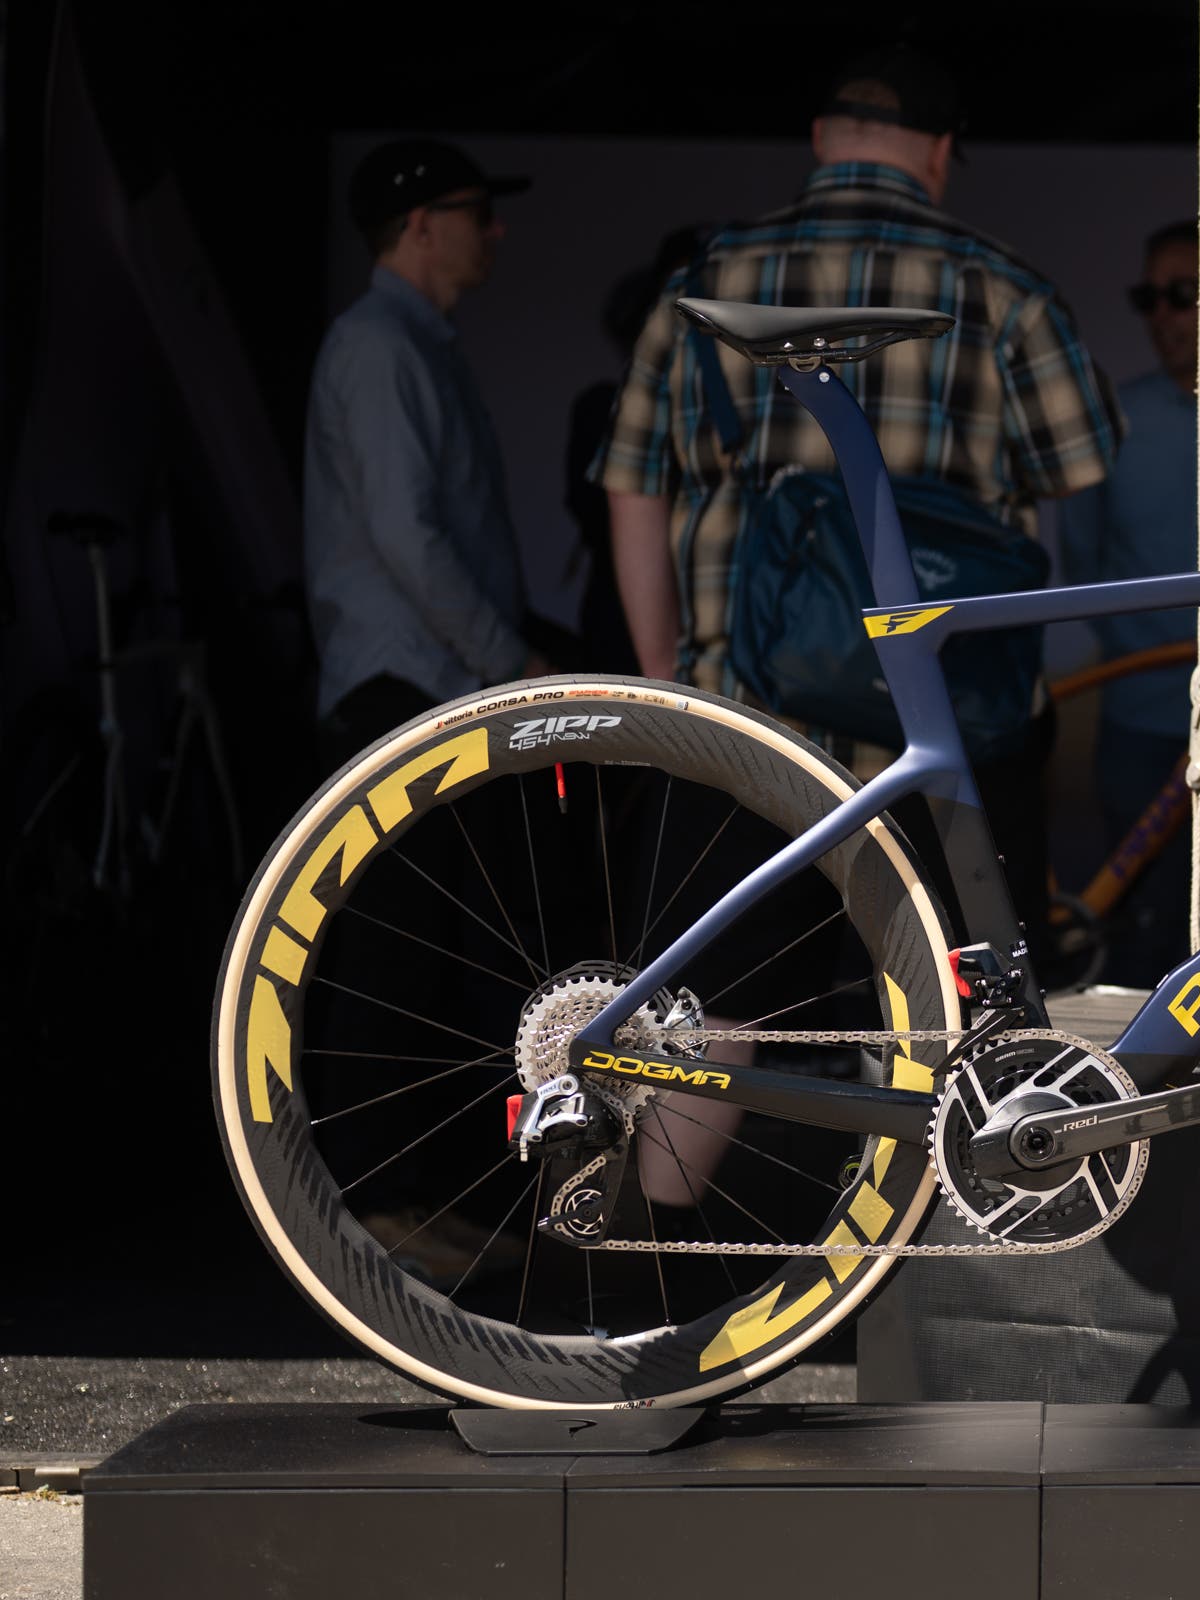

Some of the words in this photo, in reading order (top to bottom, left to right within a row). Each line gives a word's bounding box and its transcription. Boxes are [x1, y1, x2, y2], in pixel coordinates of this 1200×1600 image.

[443, 710, 473, 726] vittoria
[476, 696, 528, 714] CORSA
[532, 691, 565, 701] PRO
[509, 715, 622, 740] ZIPP
[509, 733, 552, 750] 454
[552, 732, 590, 743] NSW
[582, 1050, 732, 1090] DOGMA
